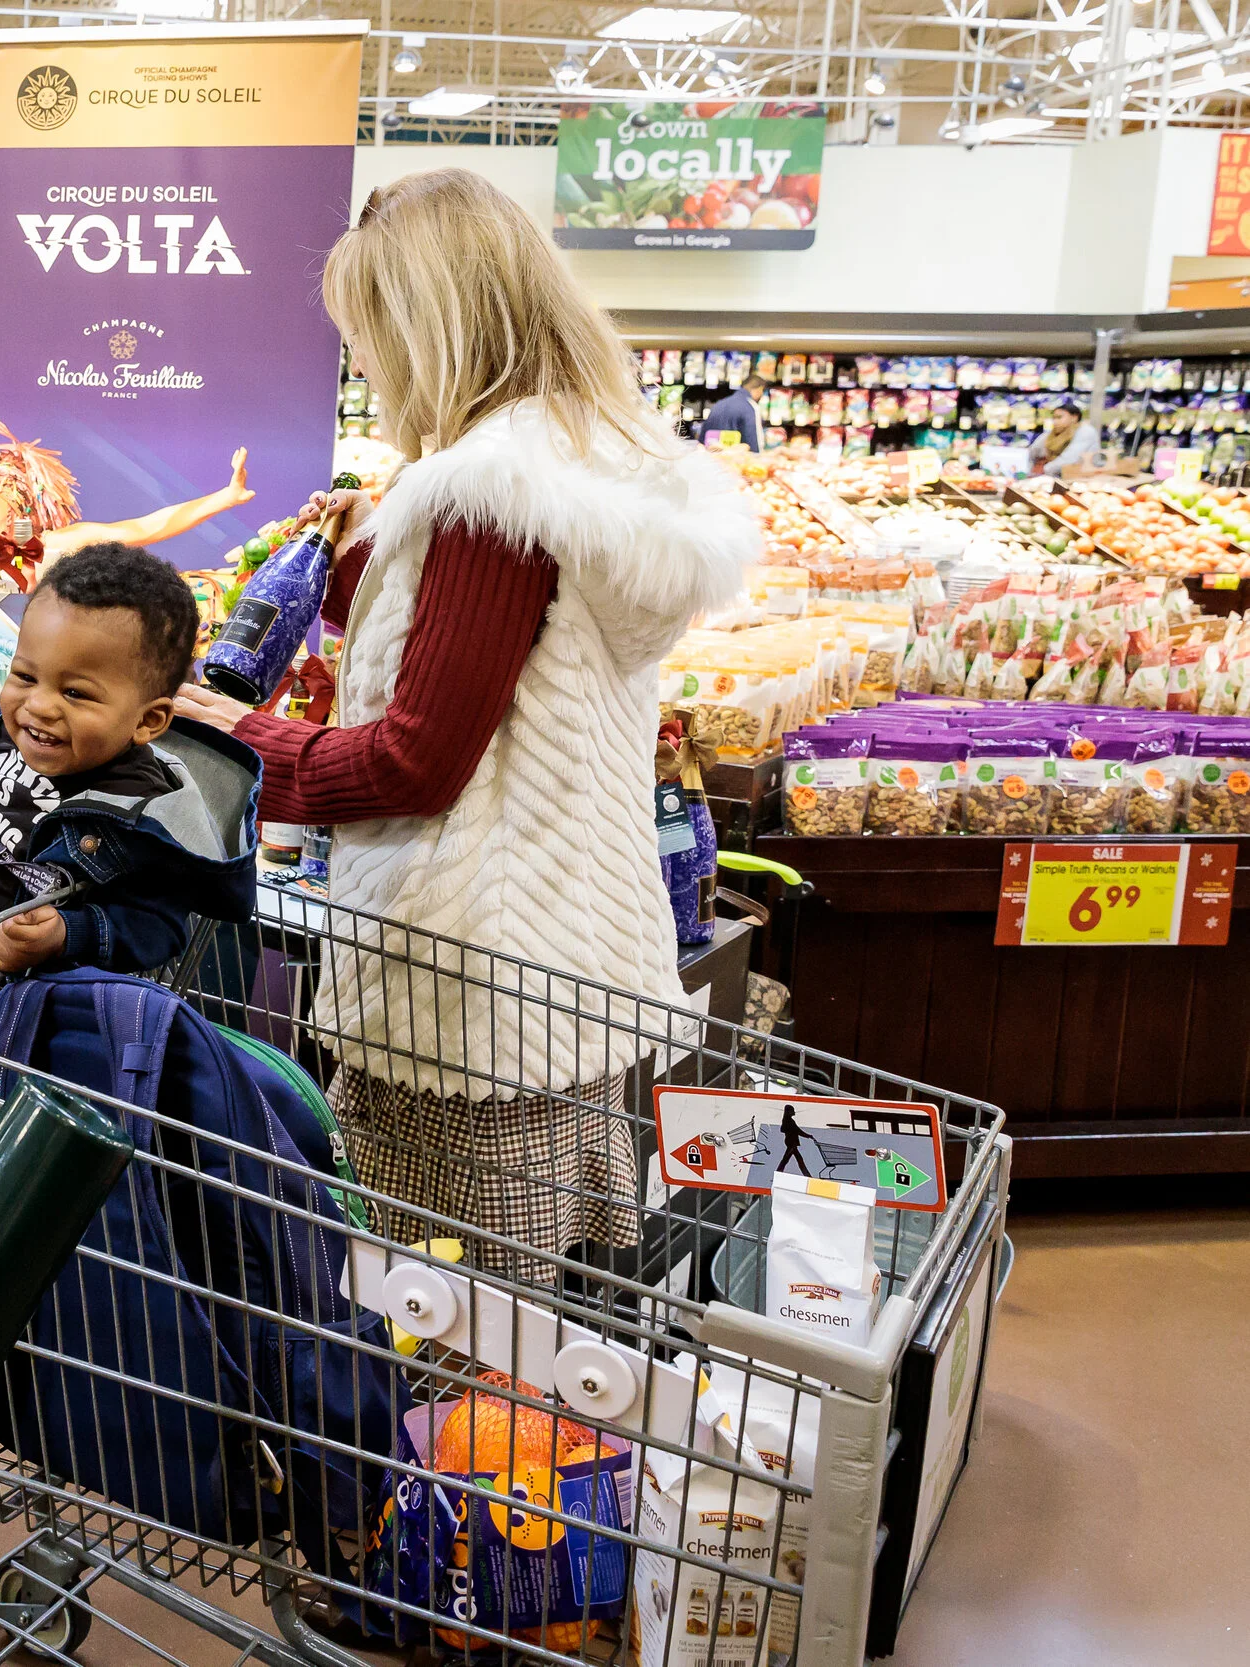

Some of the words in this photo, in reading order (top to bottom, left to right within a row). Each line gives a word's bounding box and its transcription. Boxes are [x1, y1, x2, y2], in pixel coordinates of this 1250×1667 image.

[88, 89, 158, 109] CIRQUE
[165, 89, 190, 103] DU
[196, 87, 262, 103] SOLEIL
[593, 138, 791, 193] locally
[46, 186, 117, 208] CIRQUE
[121, 186, 148, 202] DU
[152, 186, 218, 202] SOLEIL
[83, 318, 165, 338] CHAMPAGNE
[37, 359, 109, 387] Nicolas
[113, 362, 205, 389] Feuillatte
[101, 391, 138, 399] FRANCE
[1092, 847, 1124, 860] SALE
[1035, 864, 1066, 875] Simple
[1069, 864, 1090, 874] Truth
[1093, 864, 1127, 874] Pecans
[1141, 864, 1176, 875] Walnuts
[823, 1287, 838, 1297] FARM
[779, 1304, 852, 1327] chessmen
[742, 1515, 760, 1527] FARM
